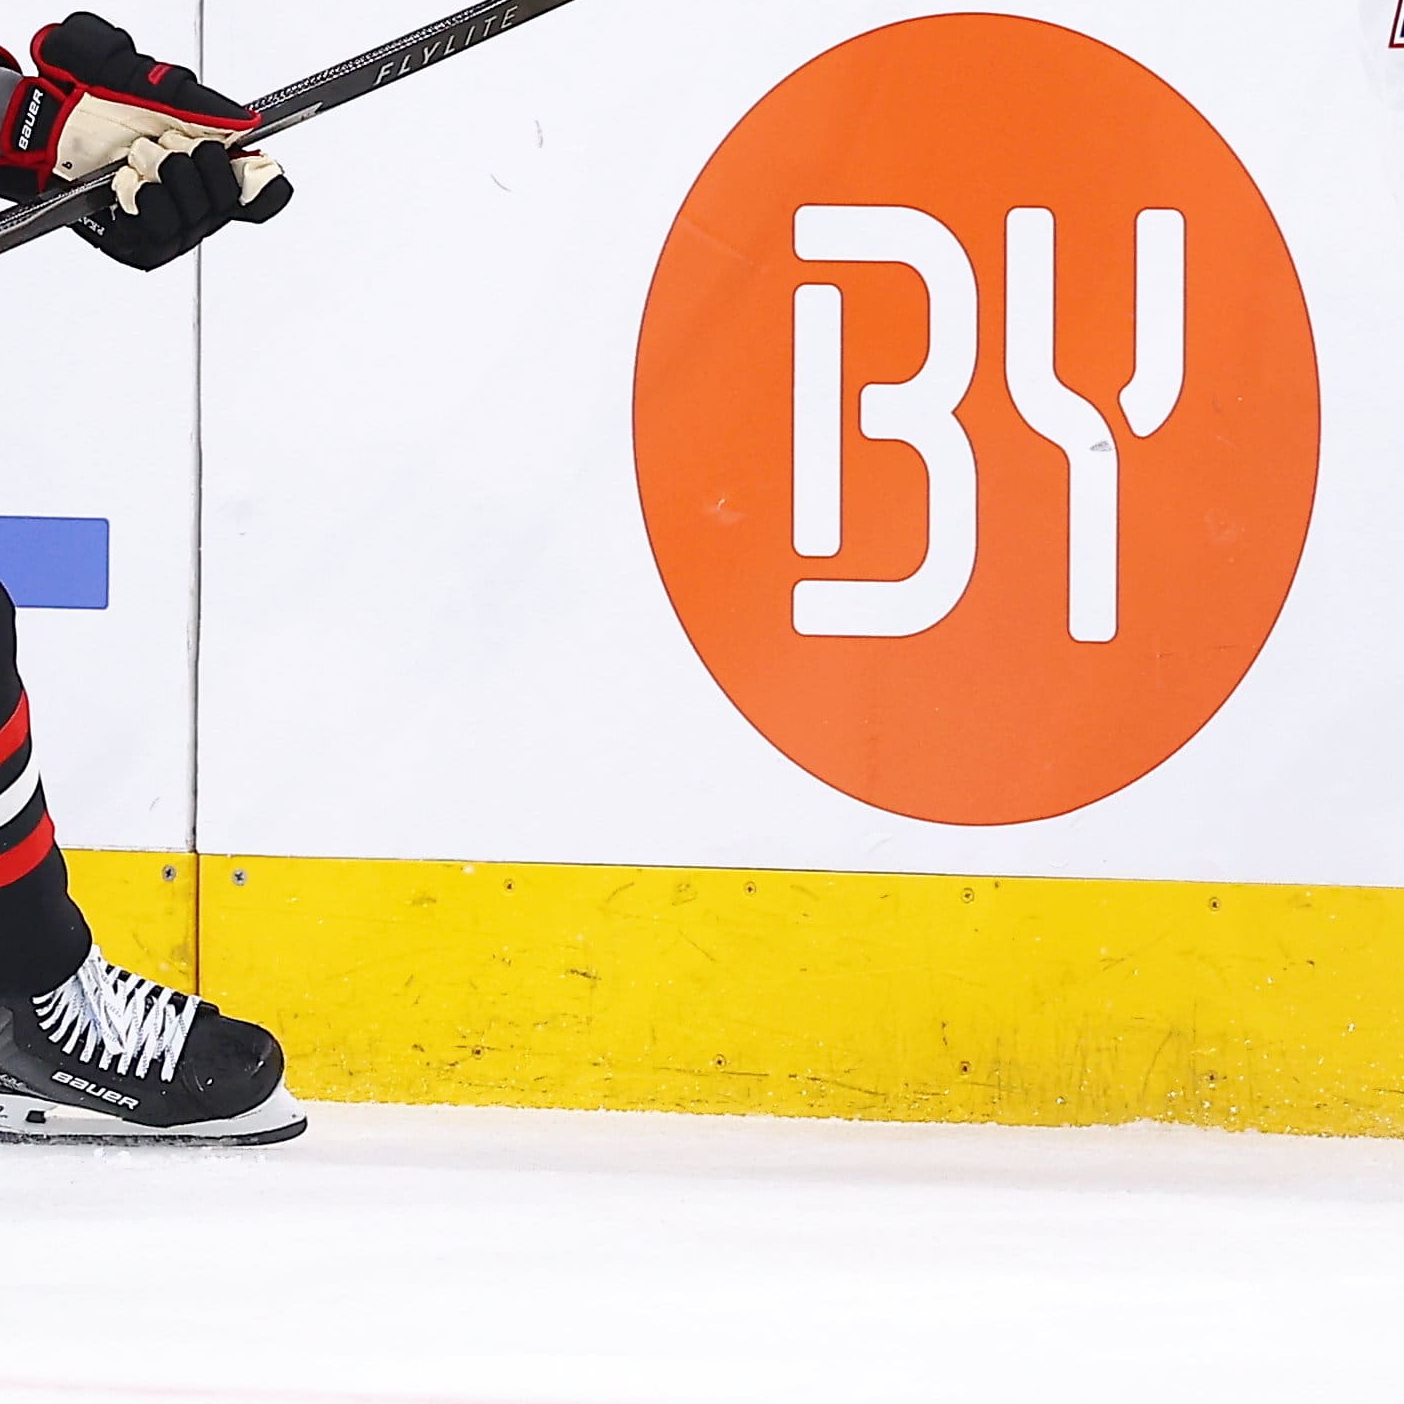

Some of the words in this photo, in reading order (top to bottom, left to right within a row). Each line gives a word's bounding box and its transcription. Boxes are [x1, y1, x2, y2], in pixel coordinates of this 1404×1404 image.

[373, 5, 519, 87] FLYLITE
[18, 88, 44, 151] BAUER
[790, 202, 1188, 645] BY
[51, 1070, 140, 1111] BAUER
